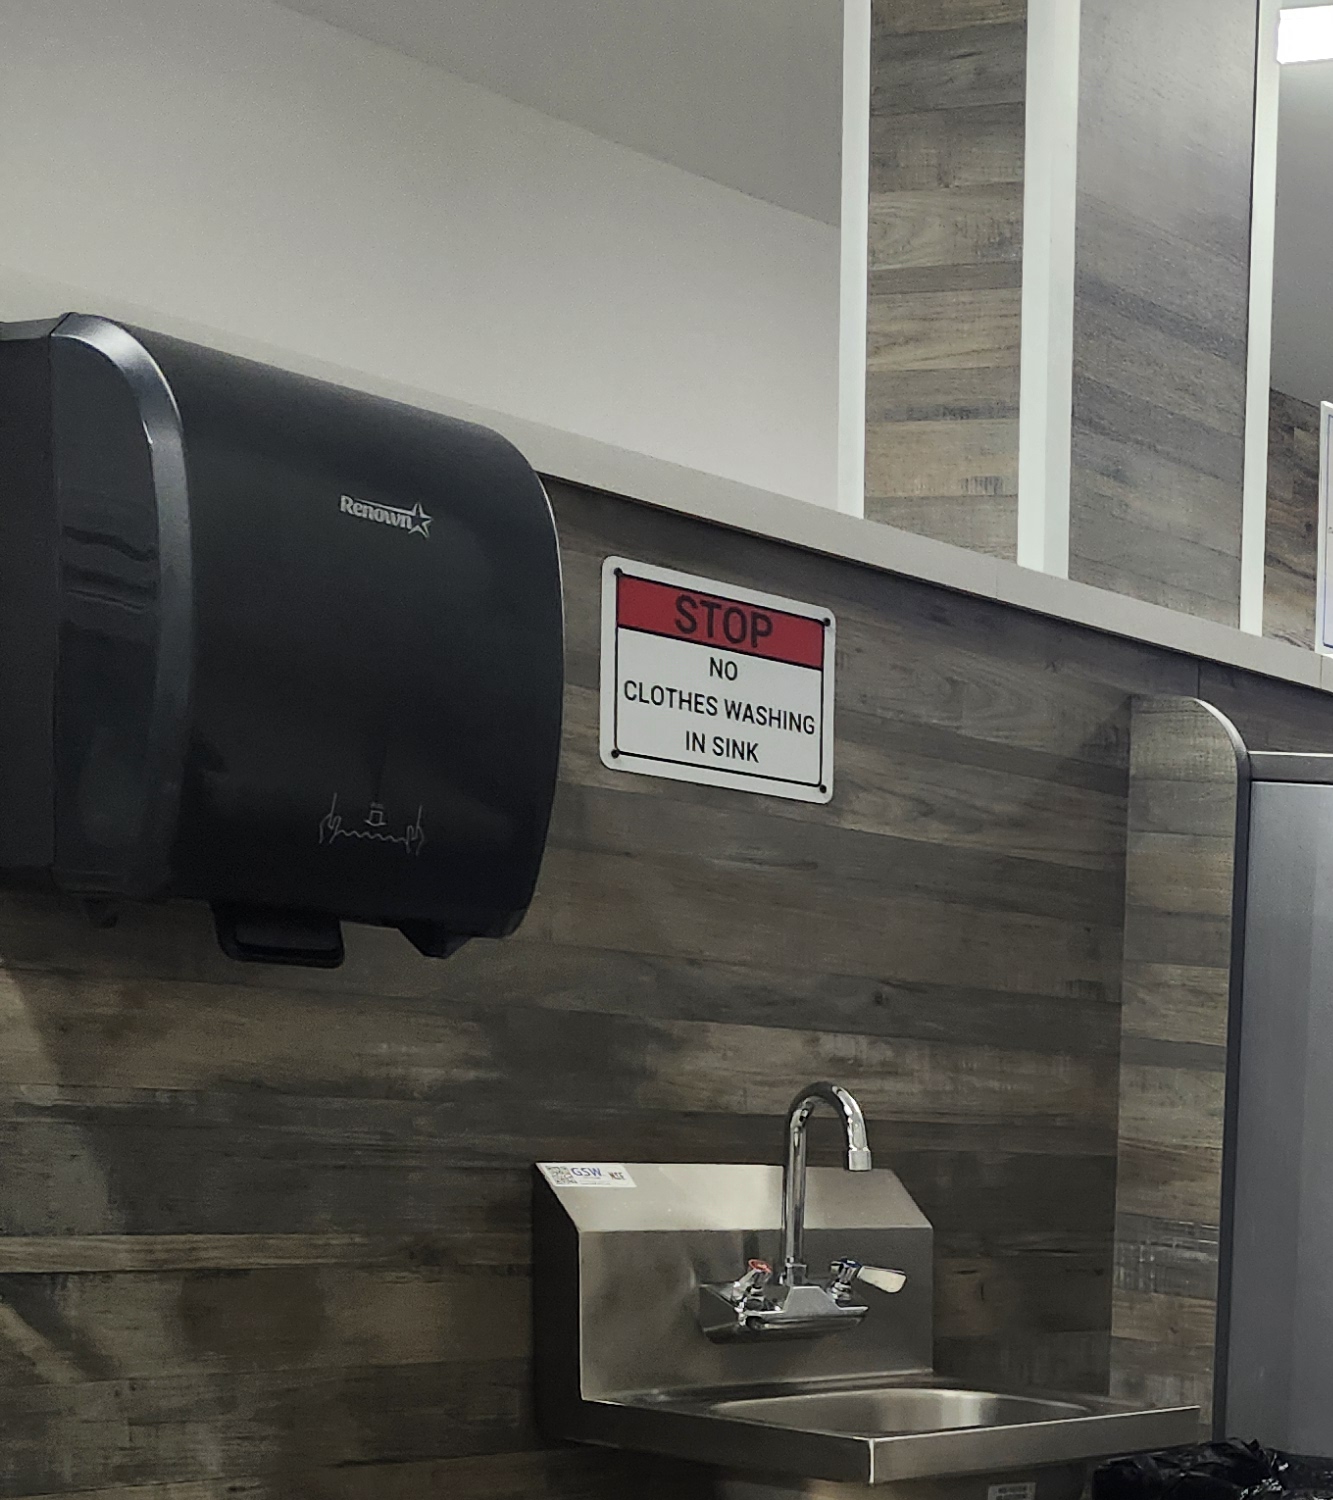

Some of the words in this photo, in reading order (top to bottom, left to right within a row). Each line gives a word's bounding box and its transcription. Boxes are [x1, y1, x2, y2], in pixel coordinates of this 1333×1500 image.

[341, 494, 412, 529] Renown
[674, 595, 773, 648] STOP
[709, 656, 738, 681] NO
[624, 680, 718, 716] CLOTHES
[724, 699, 815, 735] WASHING
[686, 731, 705, 753] IN
[712, 736, 759, 763] SINK
[571, 1167, 602, 1177] GSW
